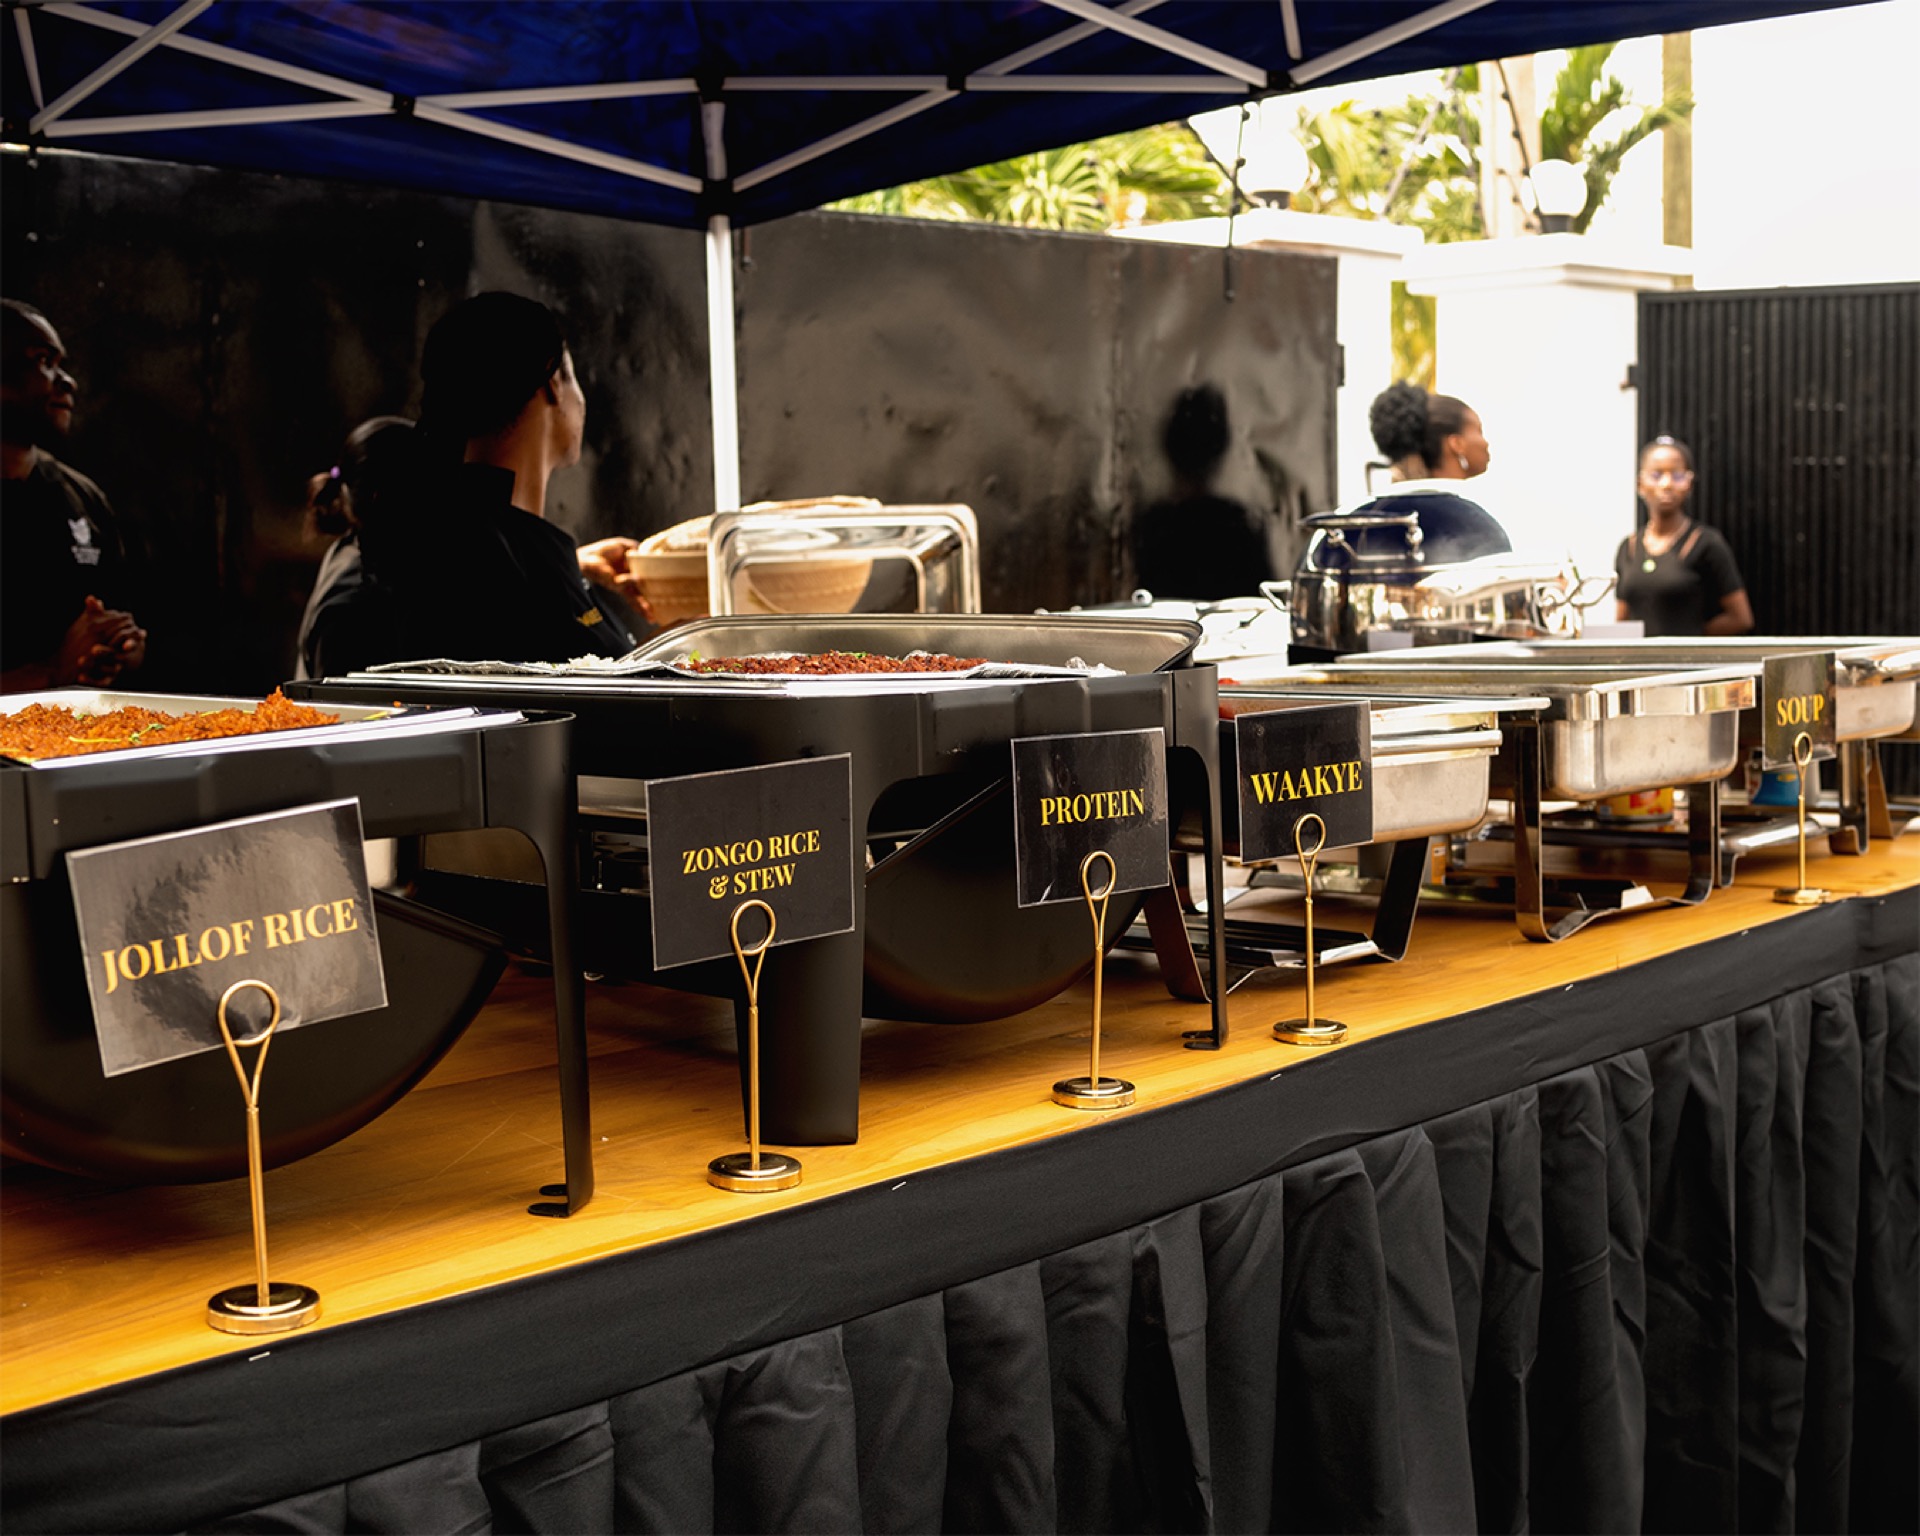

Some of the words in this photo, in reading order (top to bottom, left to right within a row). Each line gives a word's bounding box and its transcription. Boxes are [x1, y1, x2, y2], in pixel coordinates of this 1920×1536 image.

[1776, 693, 1825, 728] SOUP
[1250, 760, 1363, 805] WAAKYE
[1040, 787, 1145, 826] PROTEIN
[681, 838, 764, 875] ZONGO
[768, 829, 821, 860] RICE
[707, 874, 729, 900] &
[733, 862, 797, 895] STEW
[100, 918, 254, 994] JOLLOF
[262, 897, 359, 950] RICE
